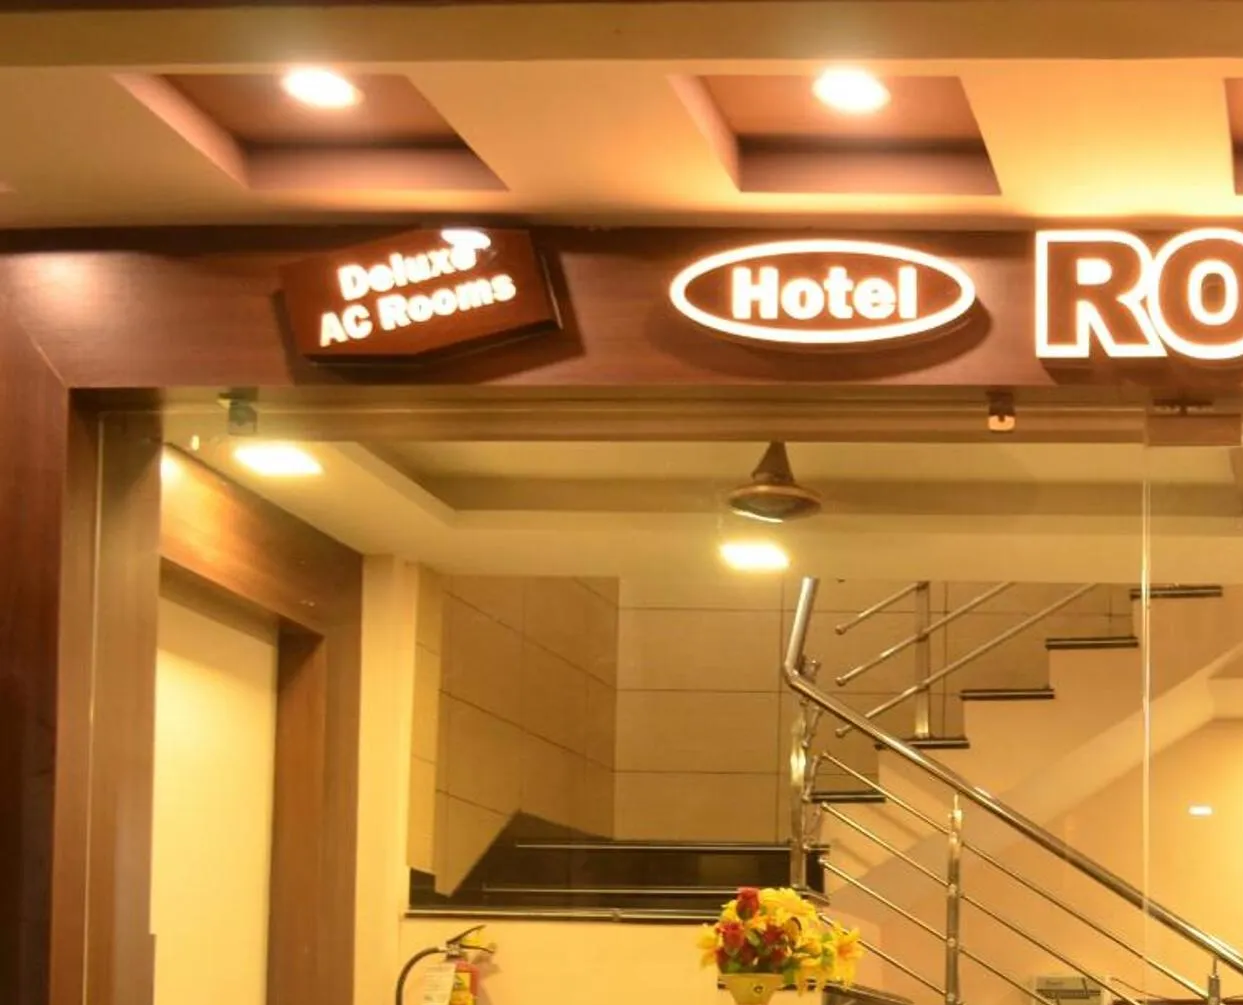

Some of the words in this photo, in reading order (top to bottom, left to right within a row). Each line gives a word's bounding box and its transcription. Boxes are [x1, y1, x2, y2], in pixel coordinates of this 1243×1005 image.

[319, 304, 373, 347] AC
[376, 274, 517, 332] Rooms
[731, 266, 919, 321] Hotel
